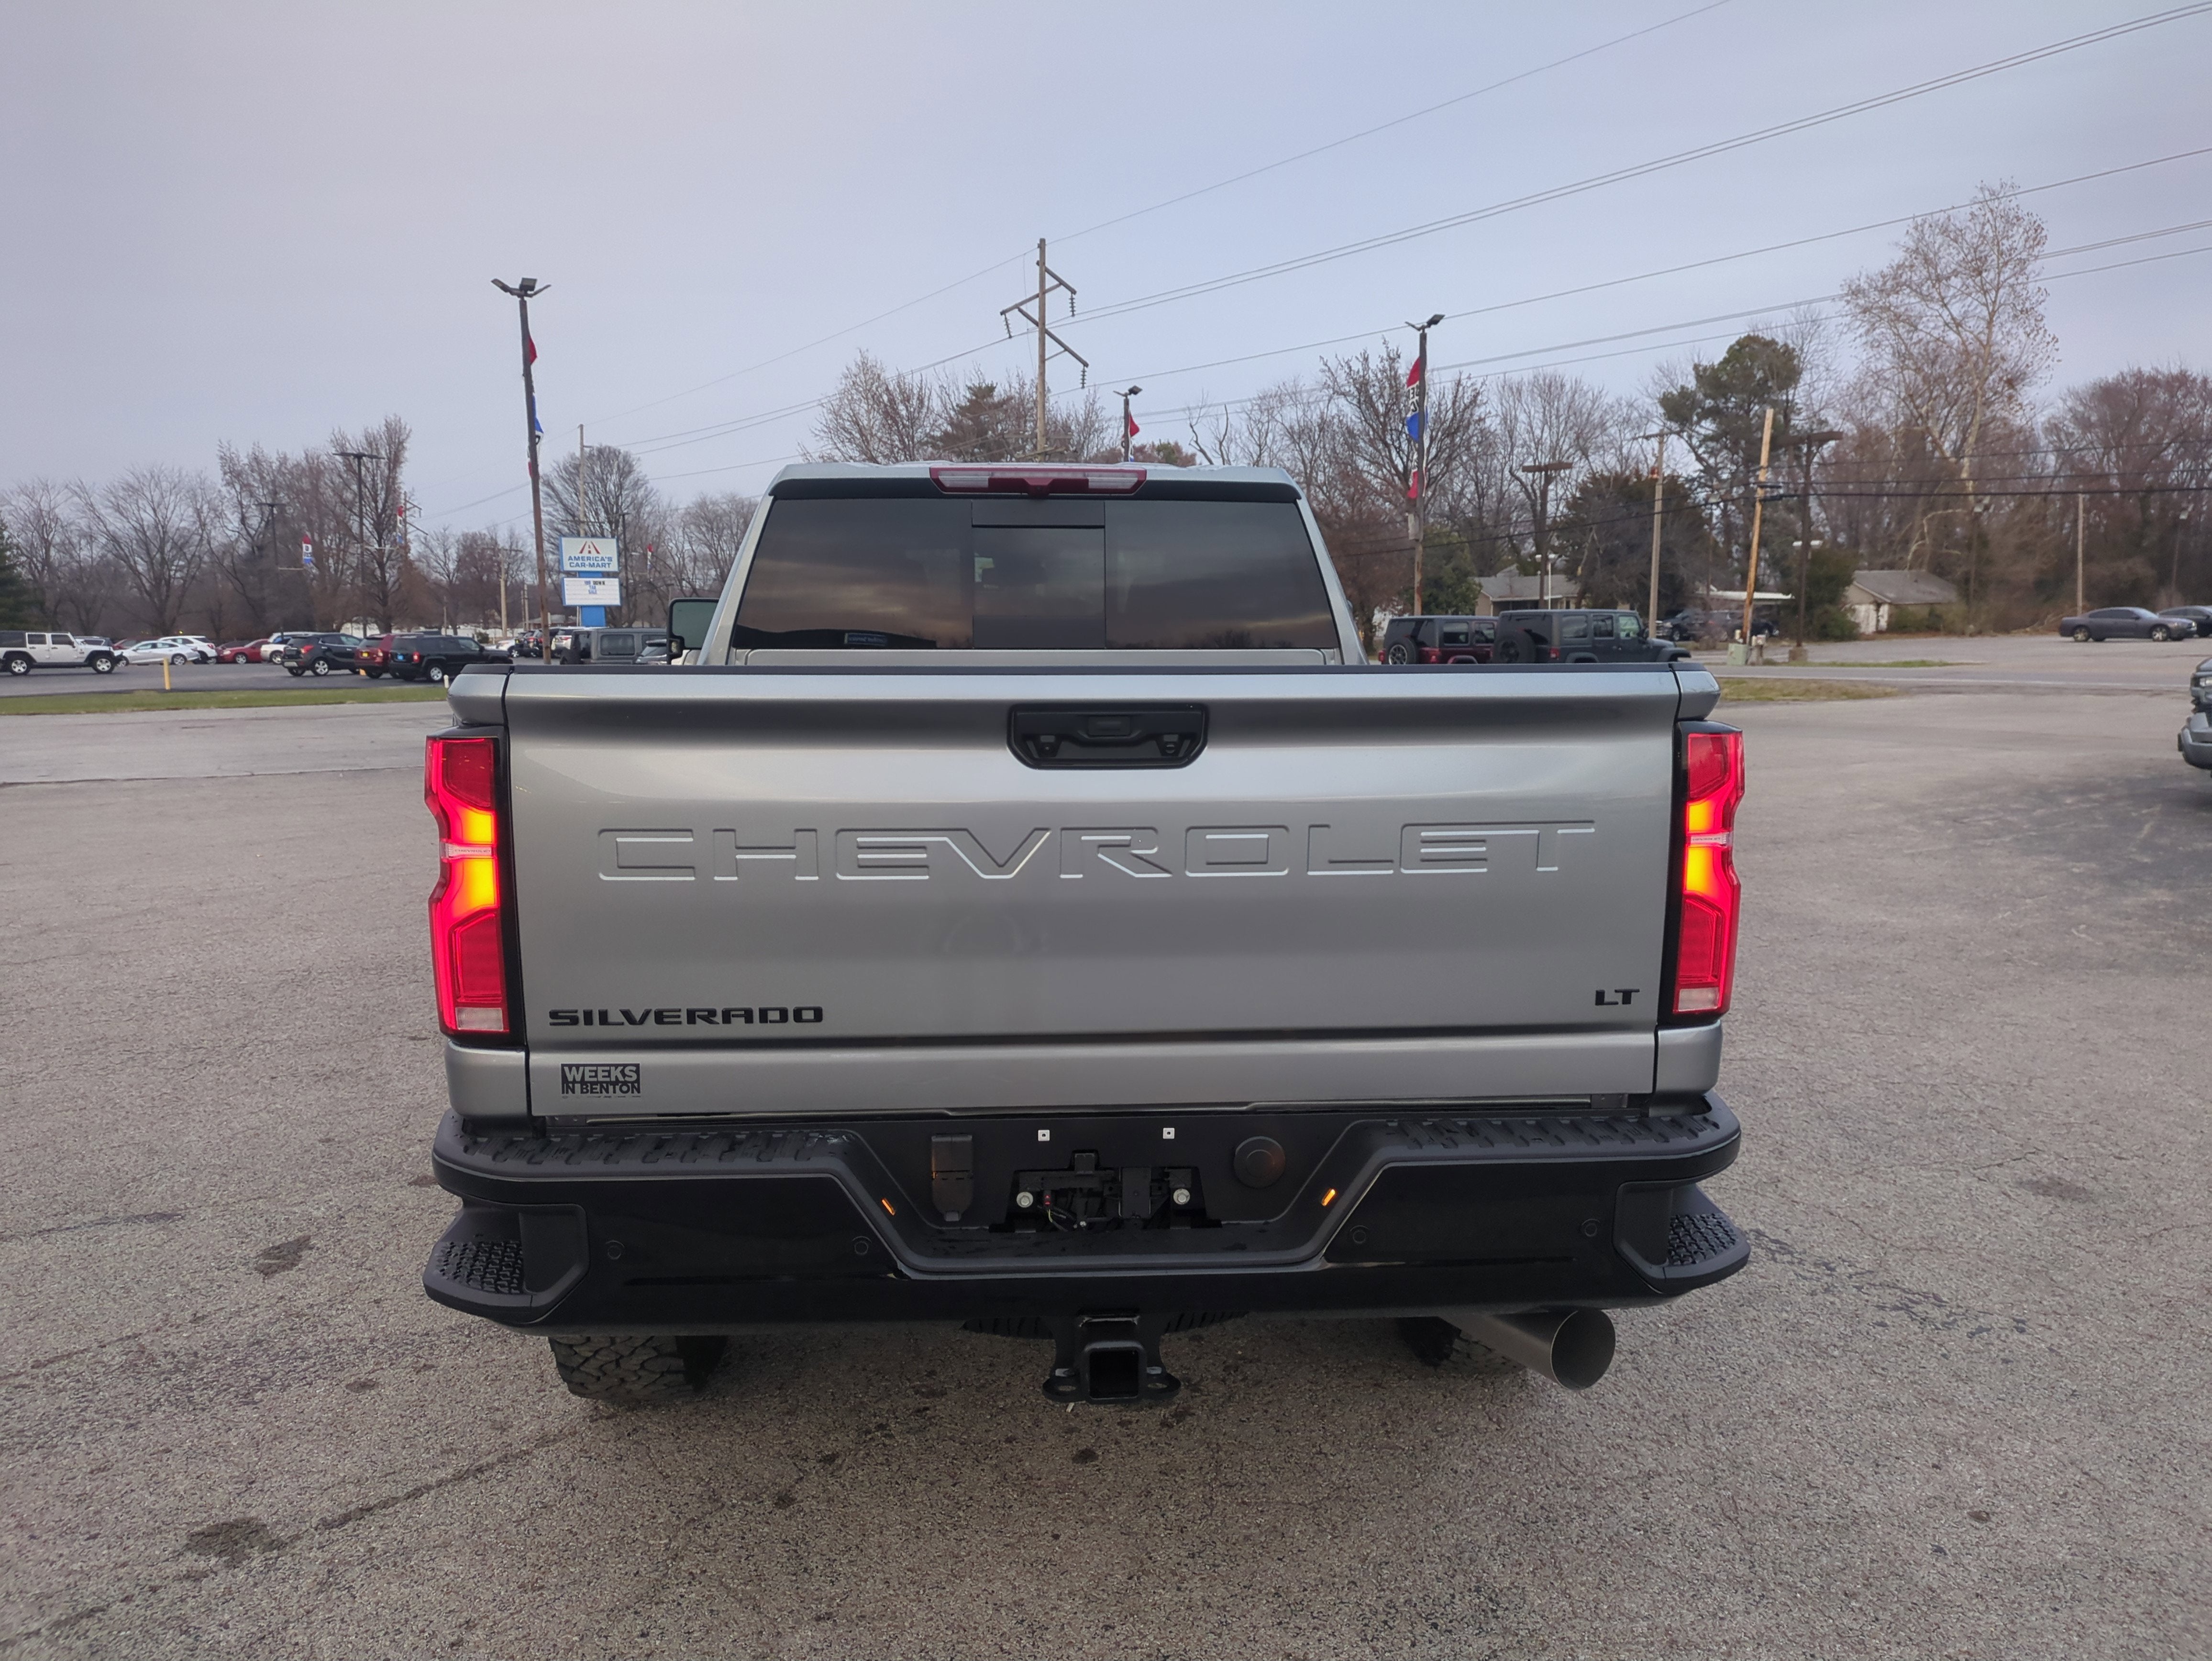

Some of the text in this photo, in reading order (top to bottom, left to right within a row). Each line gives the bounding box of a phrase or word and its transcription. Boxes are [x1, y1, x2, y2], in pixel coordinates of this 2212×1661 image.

[598, 820, 1595, 881] CHEVROLET
[1594, 988, 1640, 1006] LT
[549, 1006, 824, 1026] SILVERADO
[564, 1066, 637, 1082] WEEKS
[561, 1083, 641, 1095] IN BENTON
